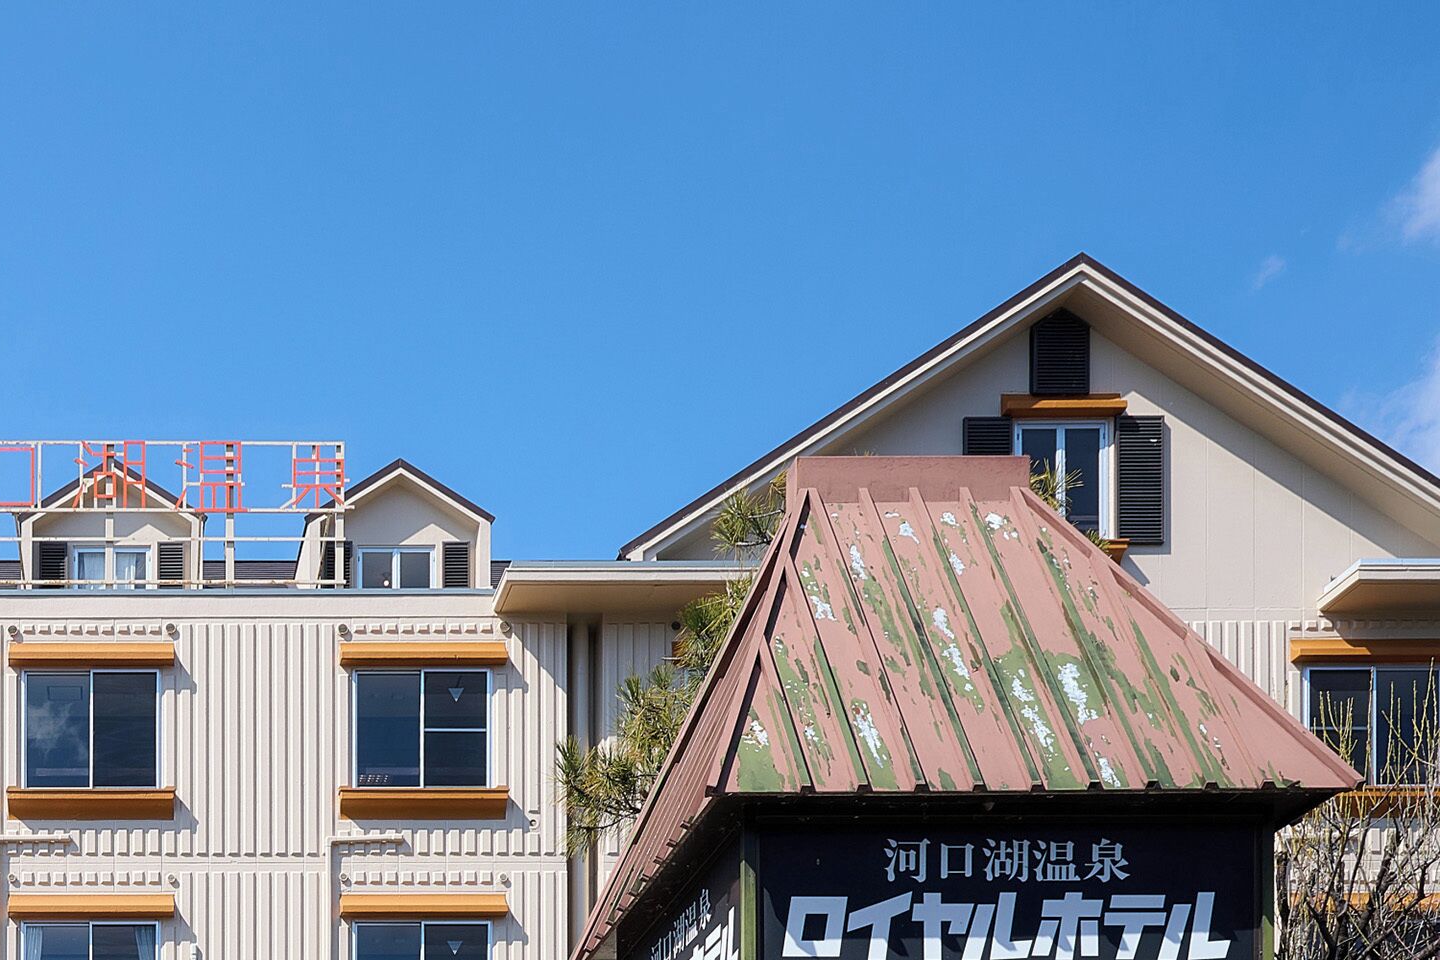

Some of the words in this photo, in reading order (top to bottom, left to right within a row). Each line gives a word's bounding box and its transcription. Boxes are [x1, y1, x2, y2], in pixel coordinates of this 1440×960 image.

[884, 838, 1130, 882] 河口湖温泉
[782, 890, 1232, 960] ロイヤルホテル
